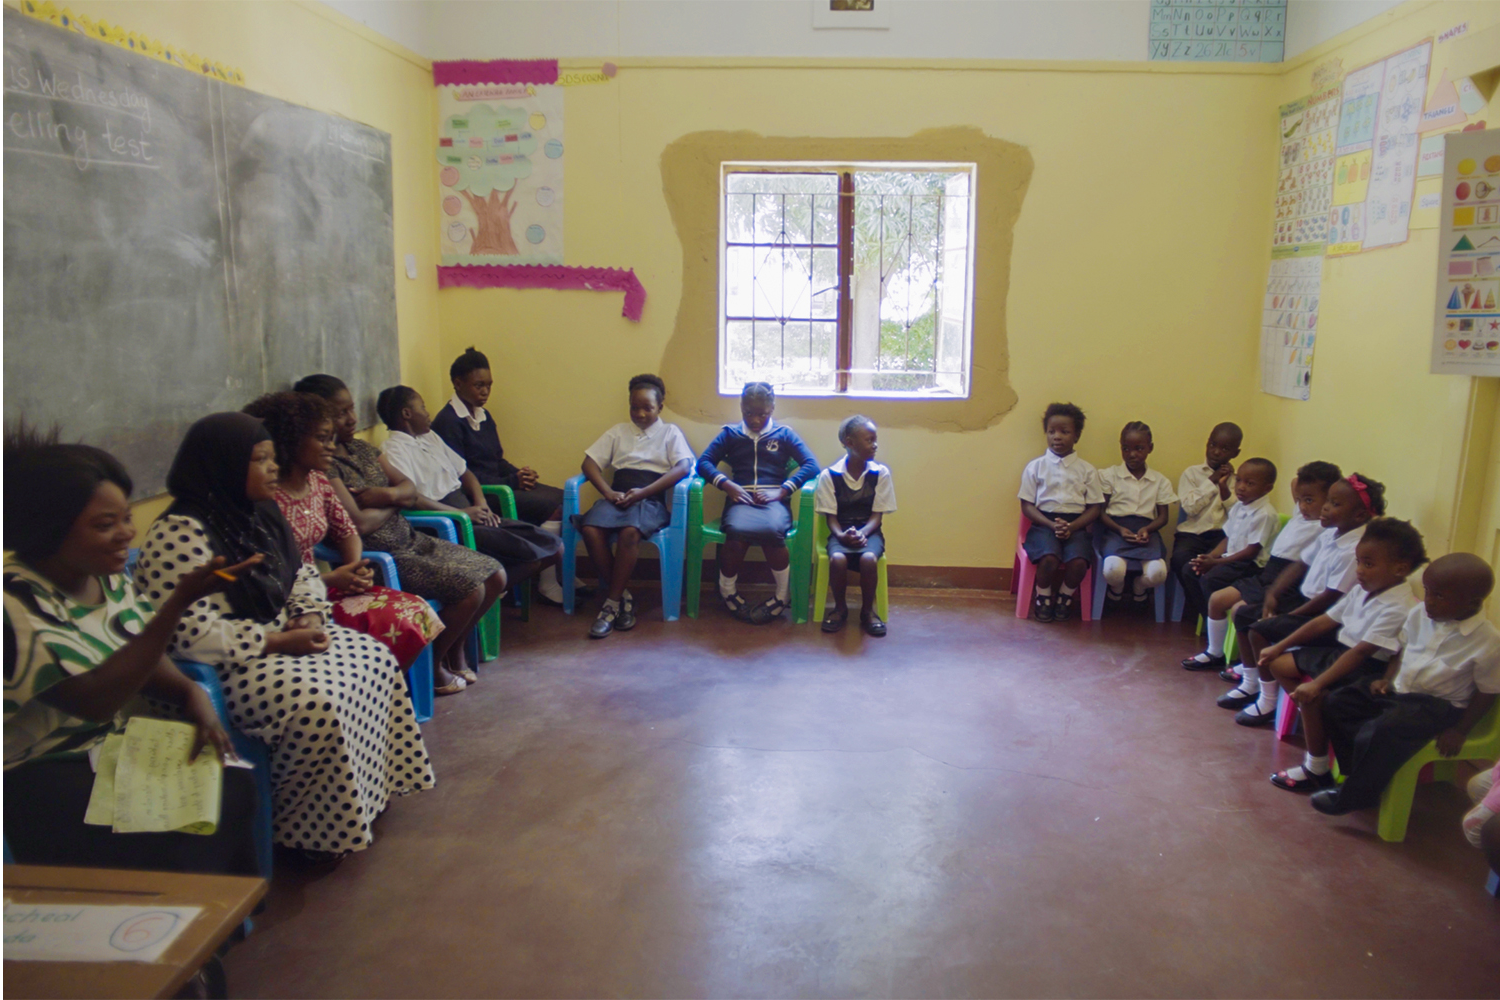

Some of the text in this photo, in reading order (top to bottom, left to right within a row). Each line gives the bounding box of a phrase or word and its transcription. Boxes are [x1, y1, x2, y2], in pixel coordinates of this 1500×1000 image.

[37, 69, 151, 133] Wednesday
[1307, 87, 1339, 106] NUMBERS
[102, 118, 153, 160] test
